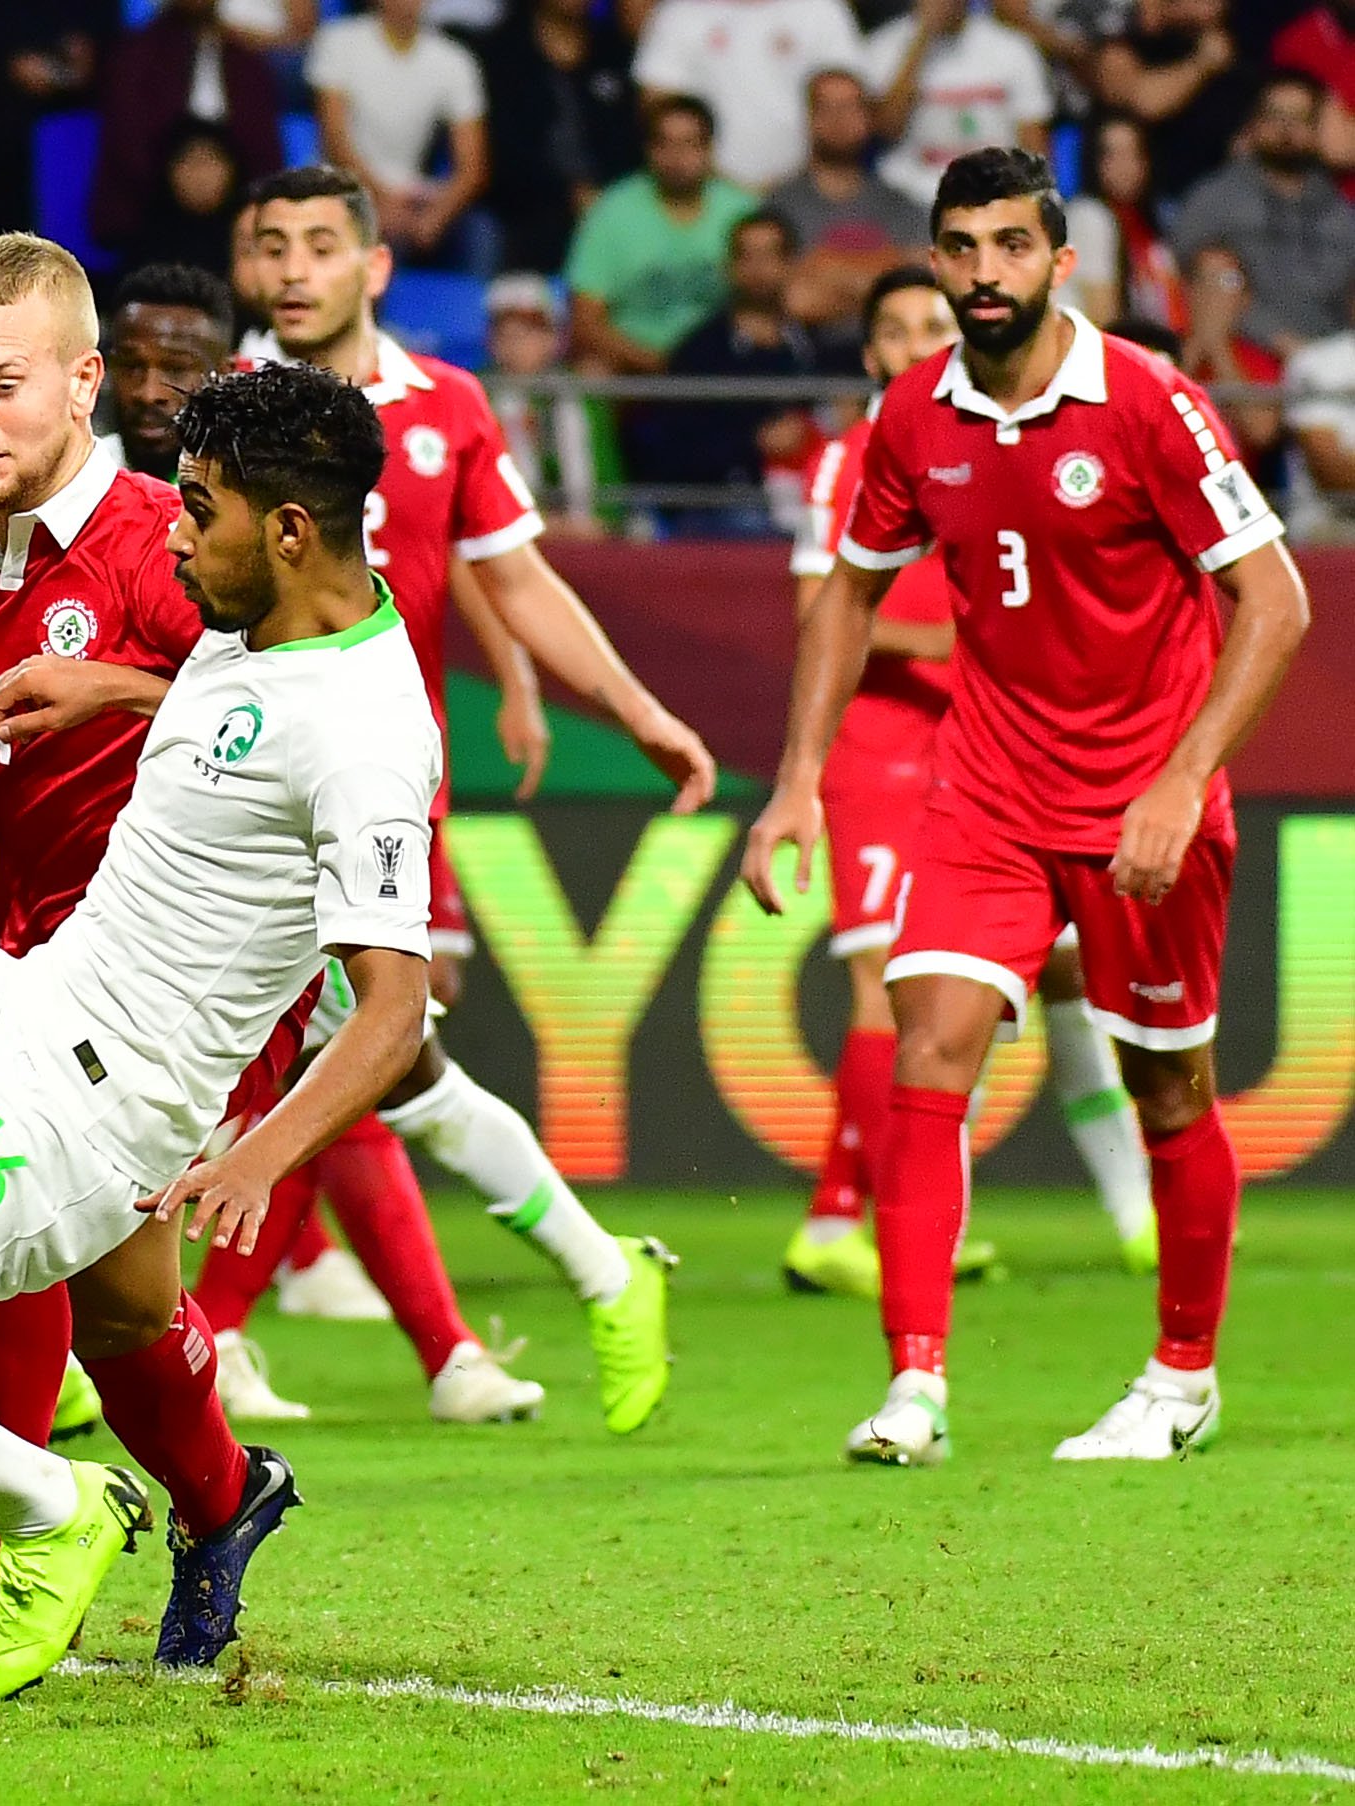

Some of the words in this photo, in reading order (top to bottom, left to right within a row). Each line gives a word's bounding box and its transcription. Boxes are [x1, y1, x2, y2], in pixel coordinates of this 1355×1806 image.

[997, 530, 1030, 607] 3
[193, 755, 221, 785] KSA
[859, 844, 897, 915] 7
